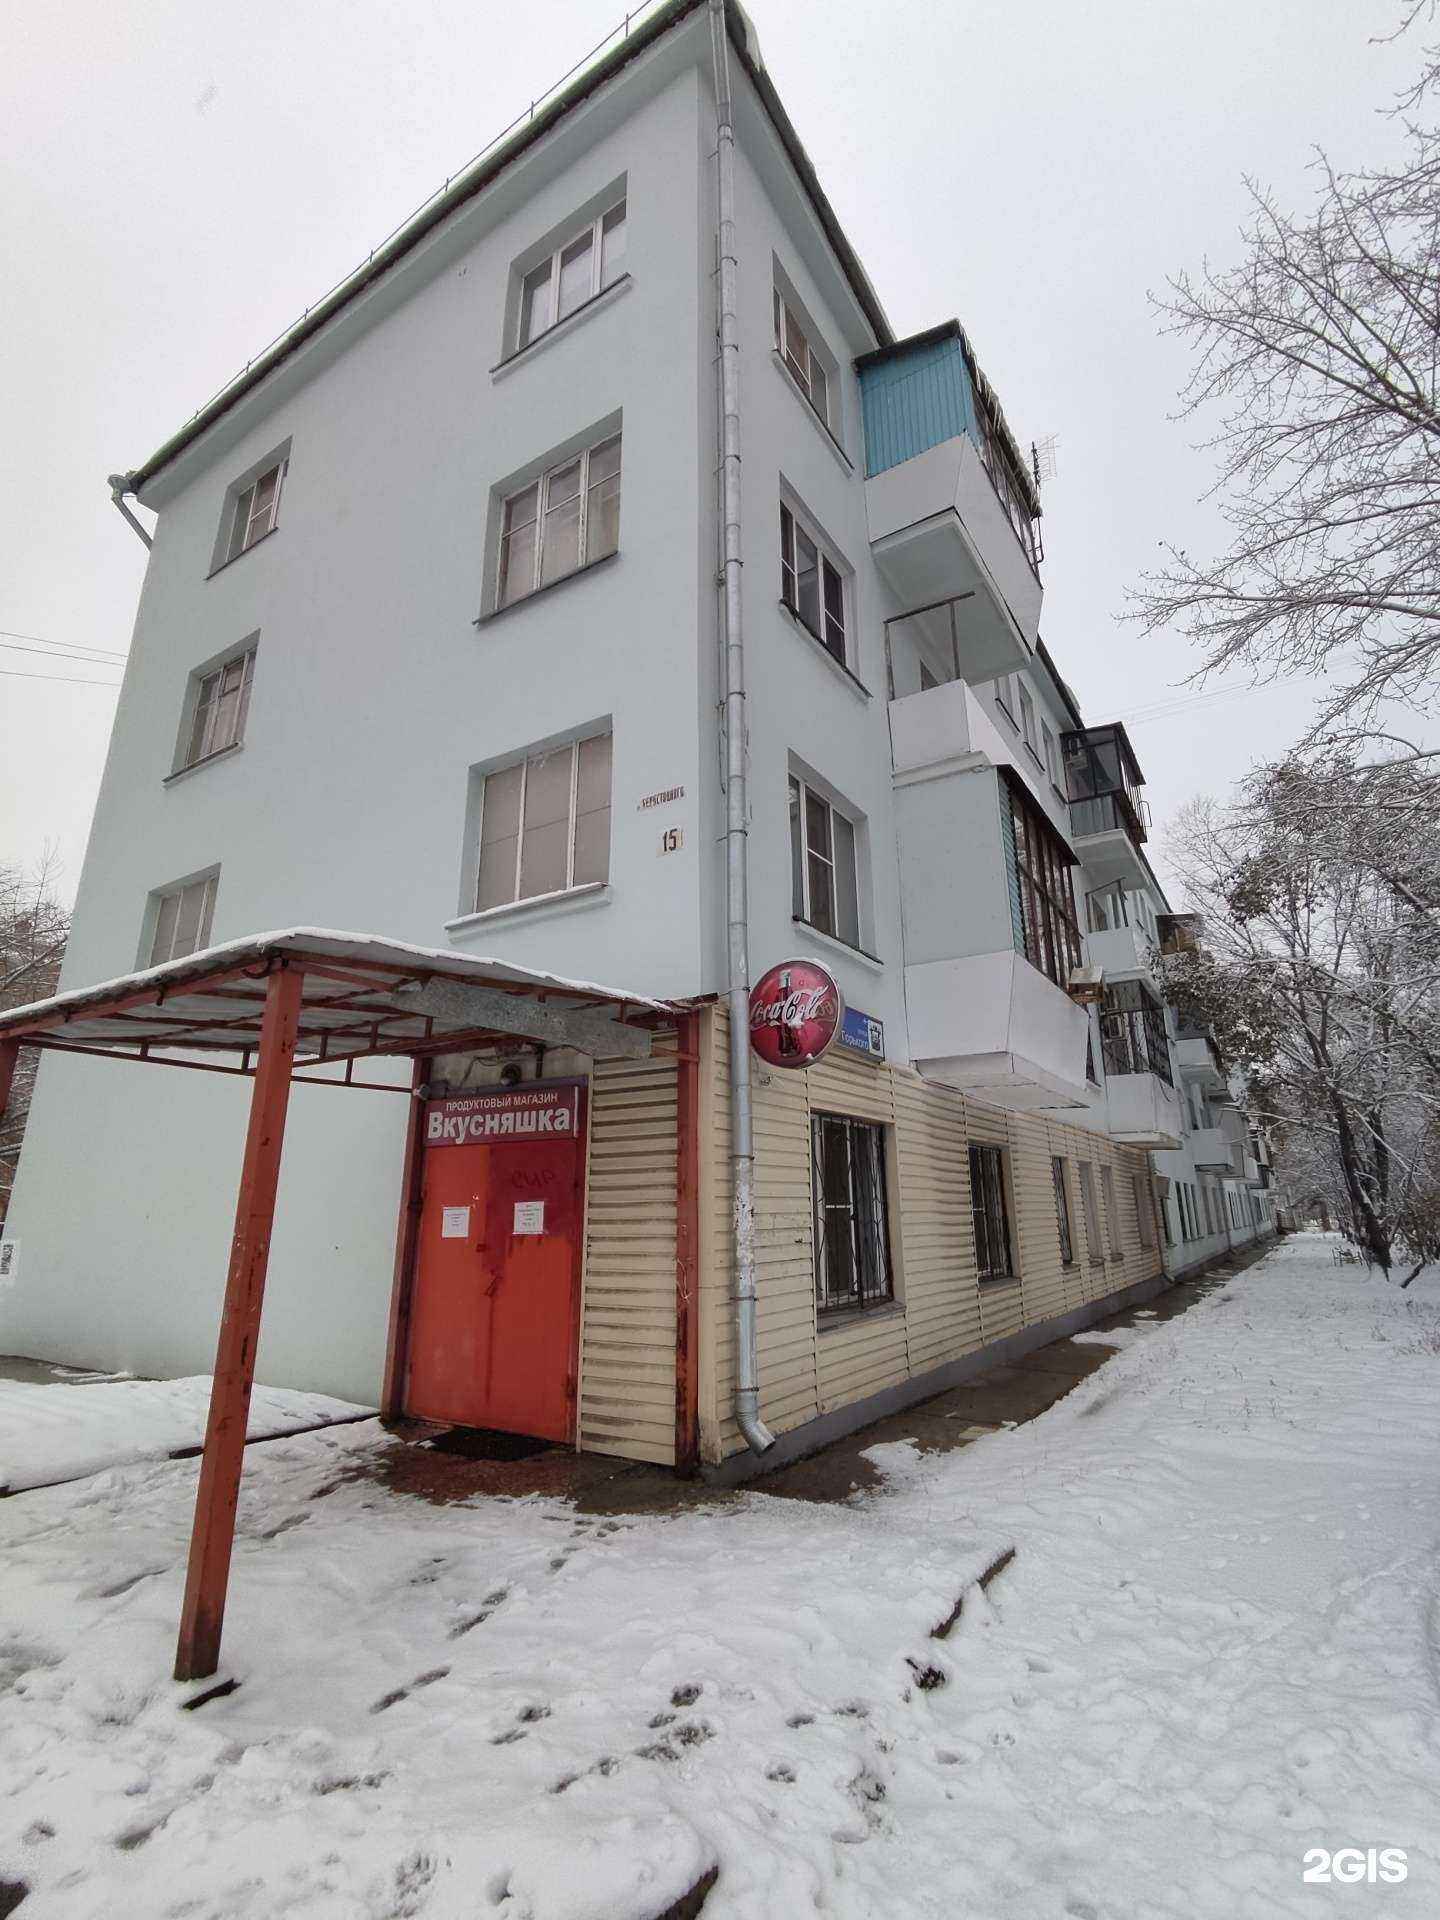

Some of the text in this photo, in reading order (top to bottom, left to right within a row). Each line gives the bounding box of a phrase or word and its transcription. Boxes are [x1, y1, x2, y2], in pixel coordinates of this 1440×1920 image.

[663, 828, 678, 852] 15
[446, 1092, 558, 1112] ПРОДУКТОВЫЙ МАГАЗИН
[427, 1107, 570, 1144] Вкусняшка
